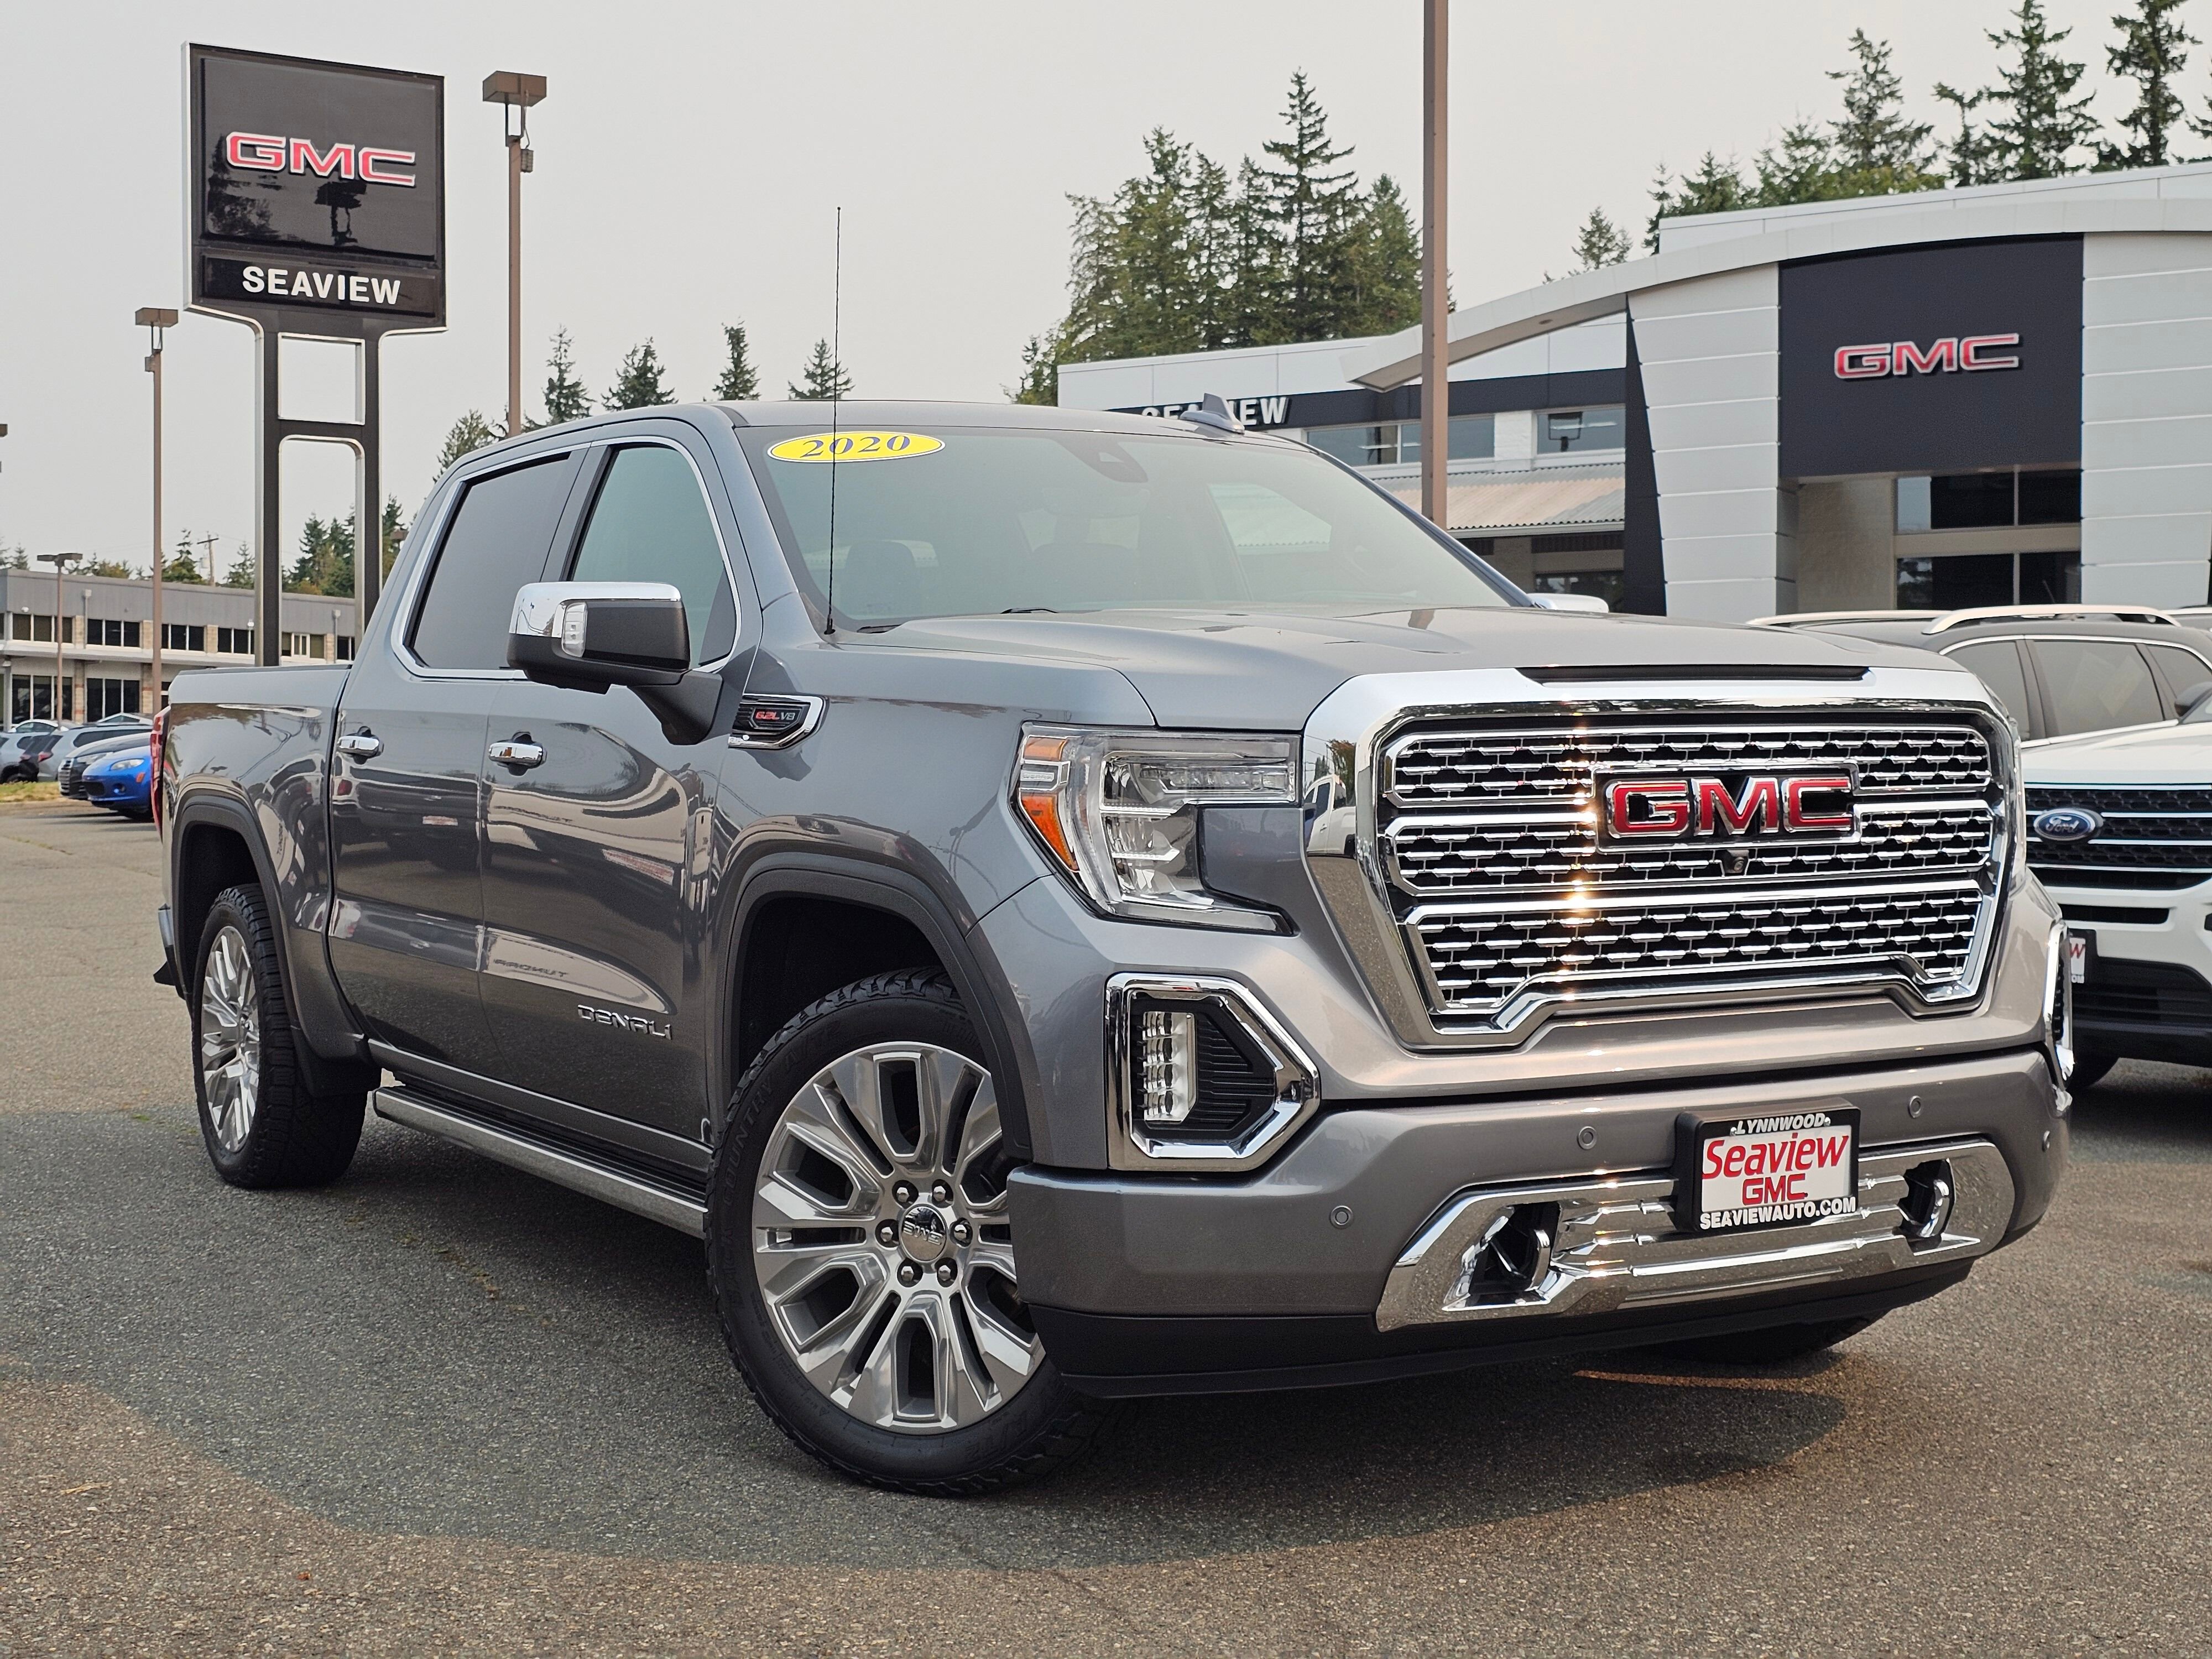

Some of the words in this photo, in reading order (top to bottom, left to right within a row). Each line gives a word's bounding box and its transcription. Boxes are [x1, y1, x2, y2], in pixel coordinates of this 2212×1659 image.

[226, 131, 416, 187] GMC
[242, 265, 401, 305] SEAVIEW
[1834, 333, 2020, 379] GMC
[800, 435, 910, 458] 2020
[780, 712, 796, 721] V8
[1605, 776, 1854, 839] GMC
[2046, 816, 2080, 833] Ford
[577, 1004, 672, 1040] DENALI
[1735, 1113, 1825, 1135] LYNNWOOD
[1702, 1132, 1849, 1179] Seaview
[1742, 1173, 1807, 1206] GMC
[1700, 1197, 1856, 1230] SEAVIEWAUTO.COM
